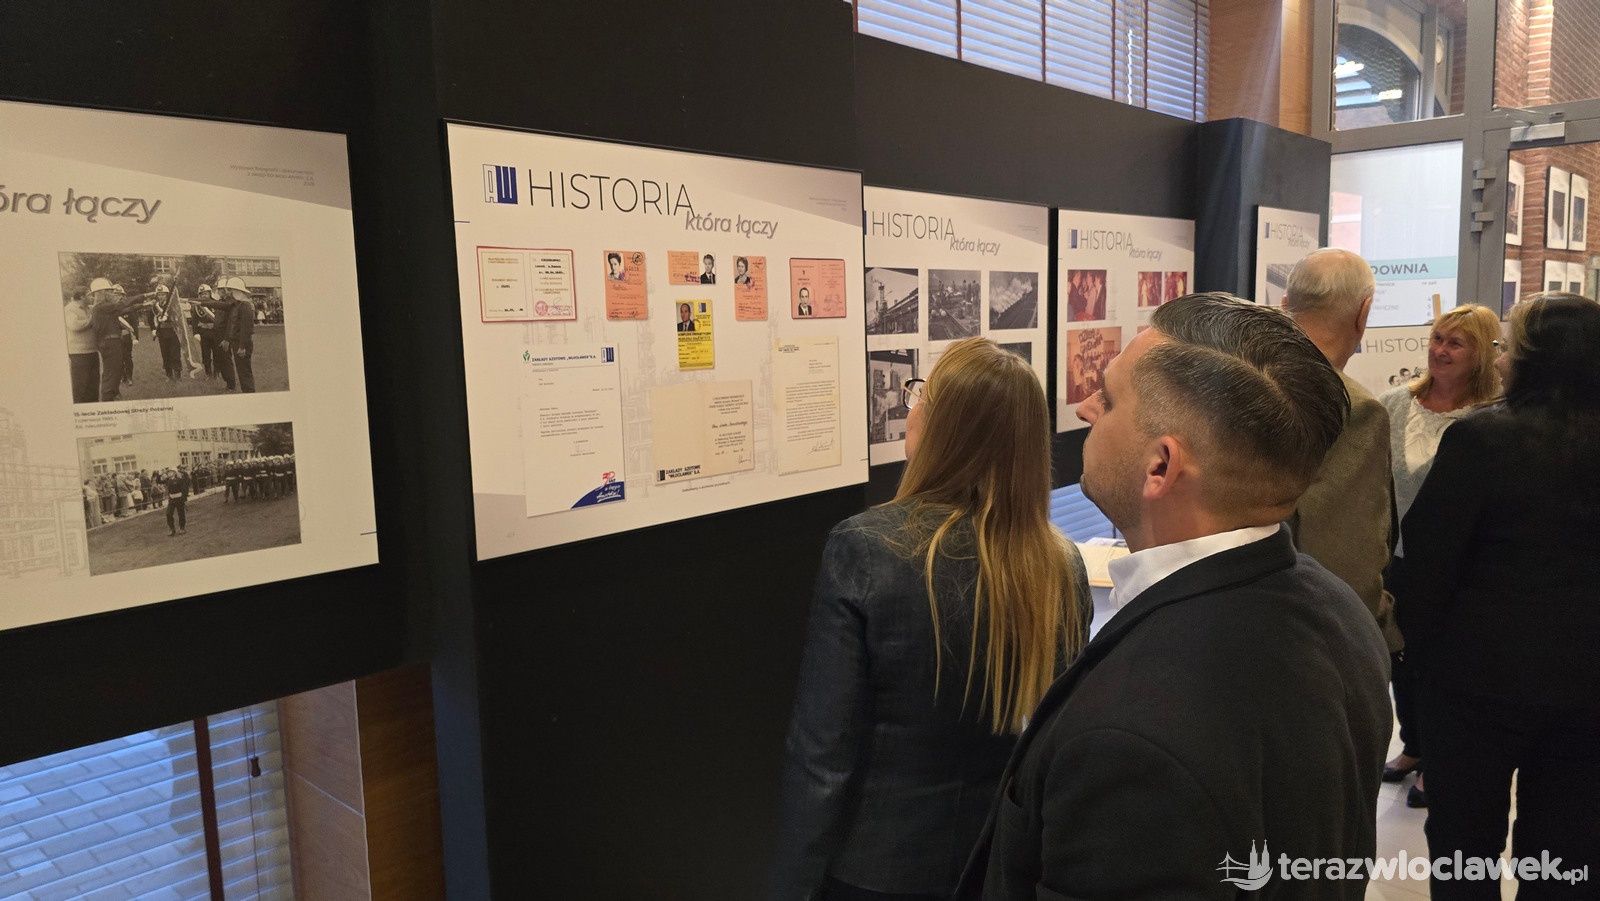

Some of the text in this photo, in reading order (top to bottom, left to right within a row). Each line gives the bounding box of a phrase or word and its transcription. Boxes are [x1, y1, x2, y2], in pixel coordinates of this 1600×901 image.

[63, 187, 162, 225] łączy
[528, 168, 696, 218] HISTORIA
[685, 210, 779, 239] która łączy
[872, 211, 956, 241] HISTORIA
[949, 237, 1001, 257] która łączy
[1080, 229, 1134, 251] HISTORIA
